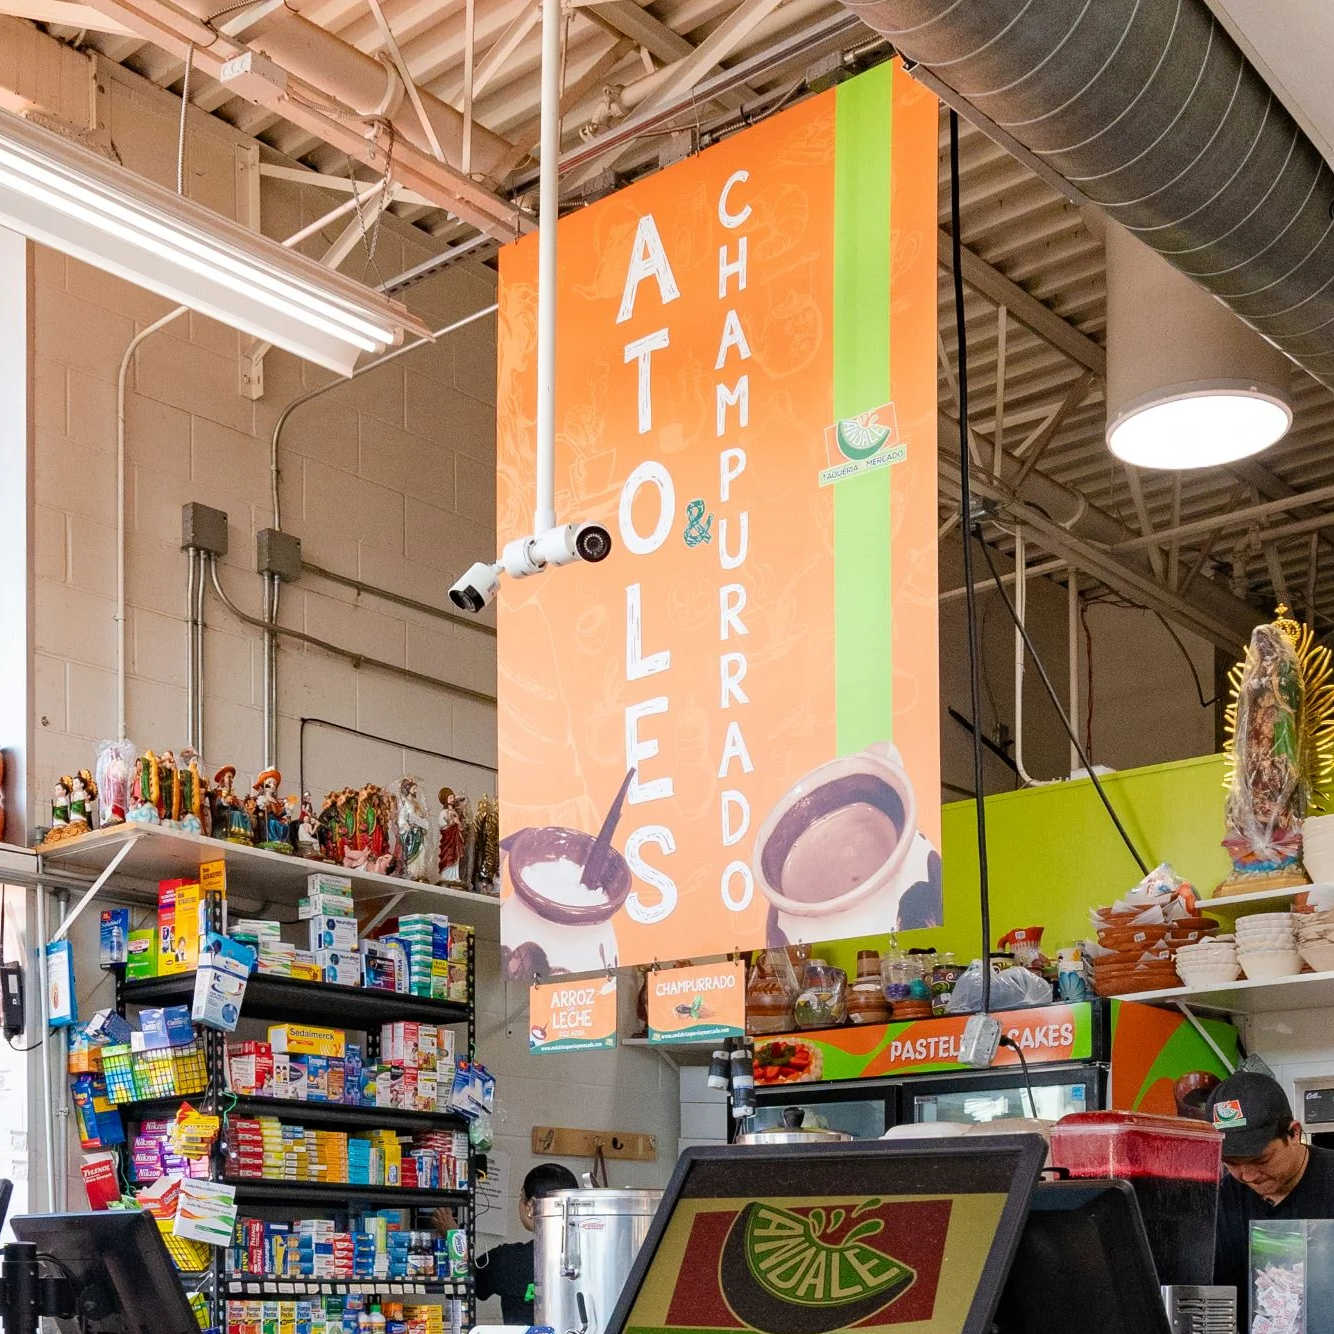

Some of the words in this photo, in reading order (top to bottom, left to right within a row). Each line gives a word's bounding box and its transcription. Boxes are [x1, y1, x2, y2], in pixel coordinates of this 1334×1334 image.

[683, 499, 713, 548] &
[715, 170, 754, 913] CHAMPURRADO
[616, 213, 681, 925] ATOLES
[550, 988, 596, 1009] ARROZ
[655, 975, 736, 997] CHAMPURRADO
[289, 1026, 335, 1042] Sedalmerck
[552, 1009, 593, 1030] LECHE
[890, 1033, 966, 1063] PASTEL
[1008, 1023, 1074, 1050] CAKES
[83, 1164, 111, 1178] TYLENOL
[753, 1208, 900, 1299] ANDALE
